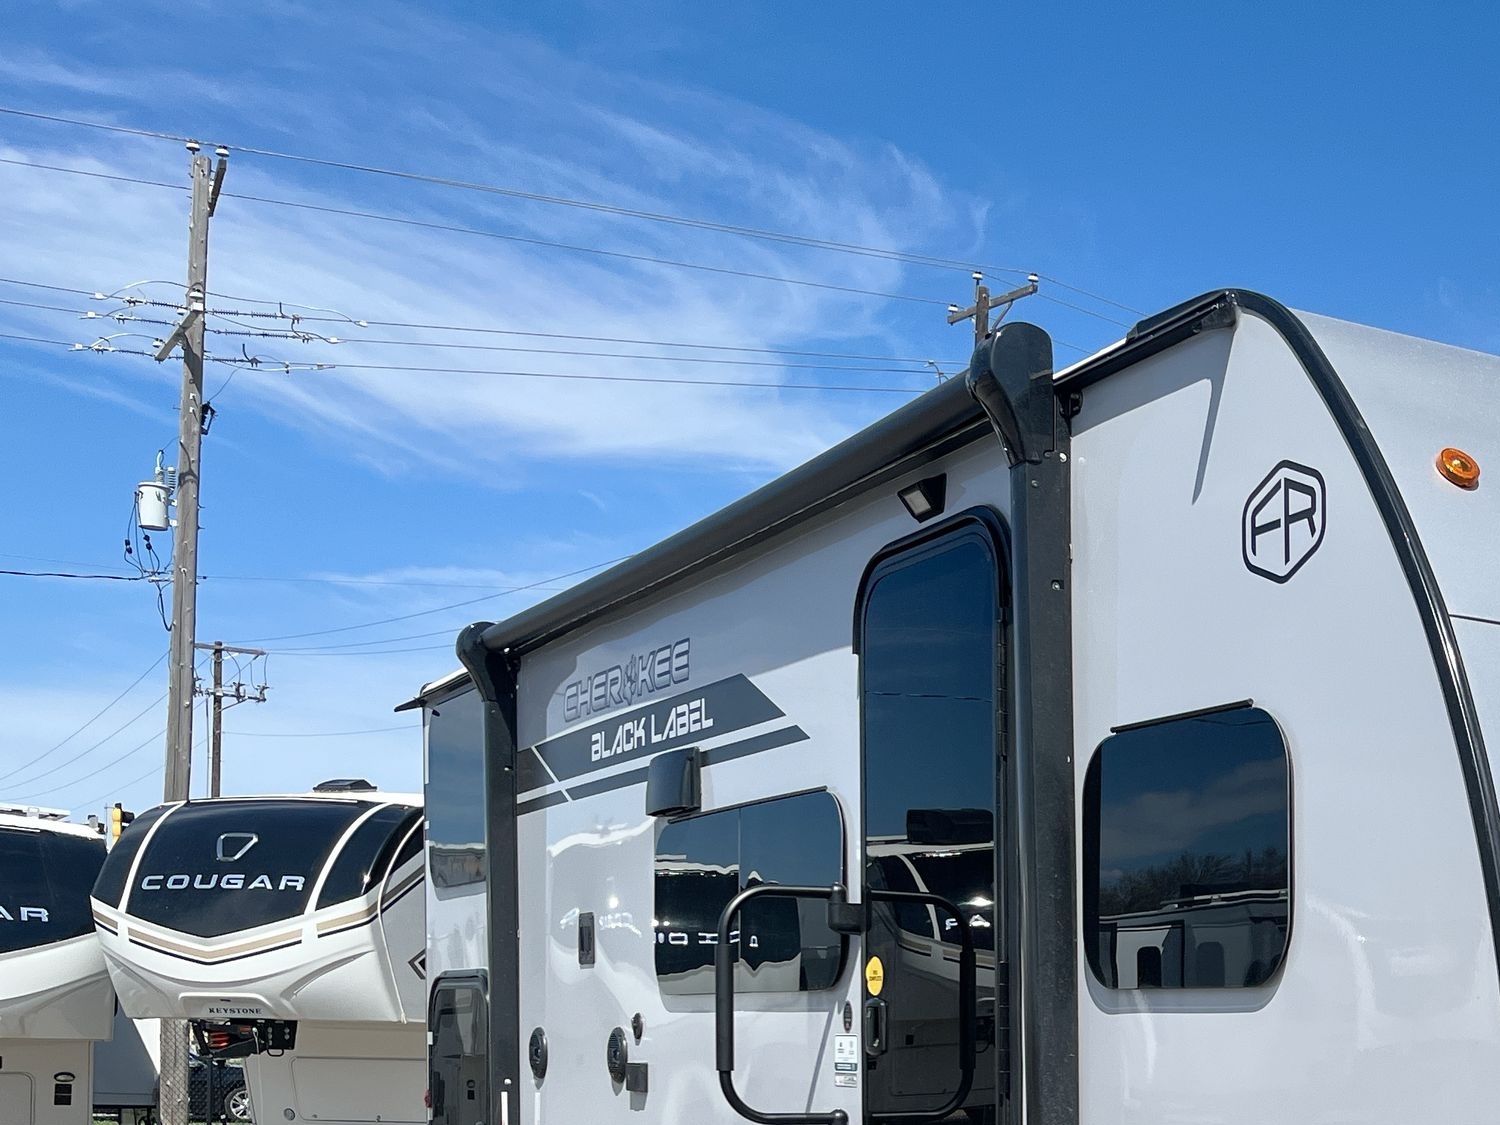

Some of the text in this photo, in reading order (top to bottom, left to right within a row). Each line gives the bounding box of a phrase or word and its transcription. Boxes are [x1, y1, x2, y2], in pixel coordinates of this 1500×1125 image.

[591, 698, 714, 762] BLACK LABEL
[141, 874, 306, 891] COUGAR
[208, 1007, 262, 1015] KEYSTONE
